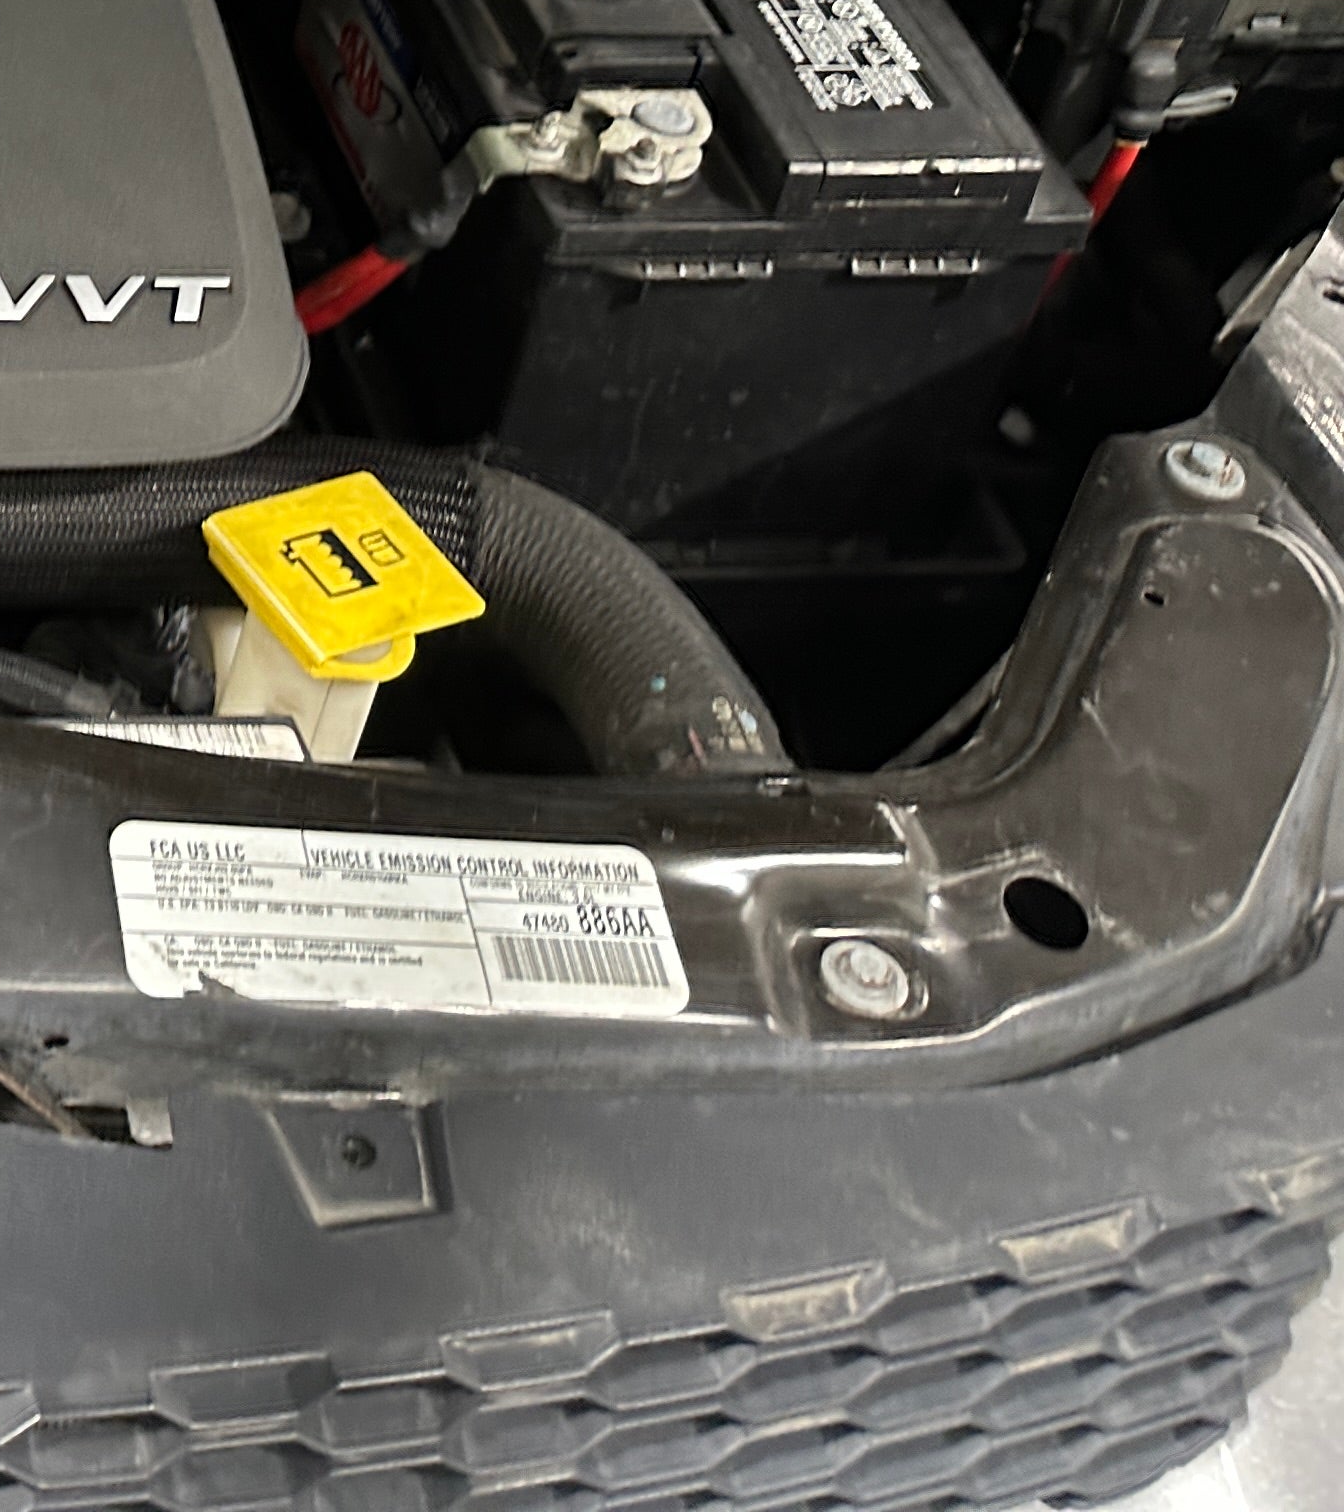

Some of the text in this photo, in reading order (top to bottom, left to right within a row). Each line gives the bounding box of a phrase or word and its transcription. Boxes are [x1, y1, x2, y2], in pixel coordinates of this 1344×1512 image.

[150, 839, 245, 863] FCA US LLC
[311, 848, 374, 870] VEHICLE
[379, 851, 452, 874] EMISSION
[457, 855, 528, 878] CONTROL
[533, 857, 638, 883] INFORMATION
[576, 904, 655, 938] 886AA
